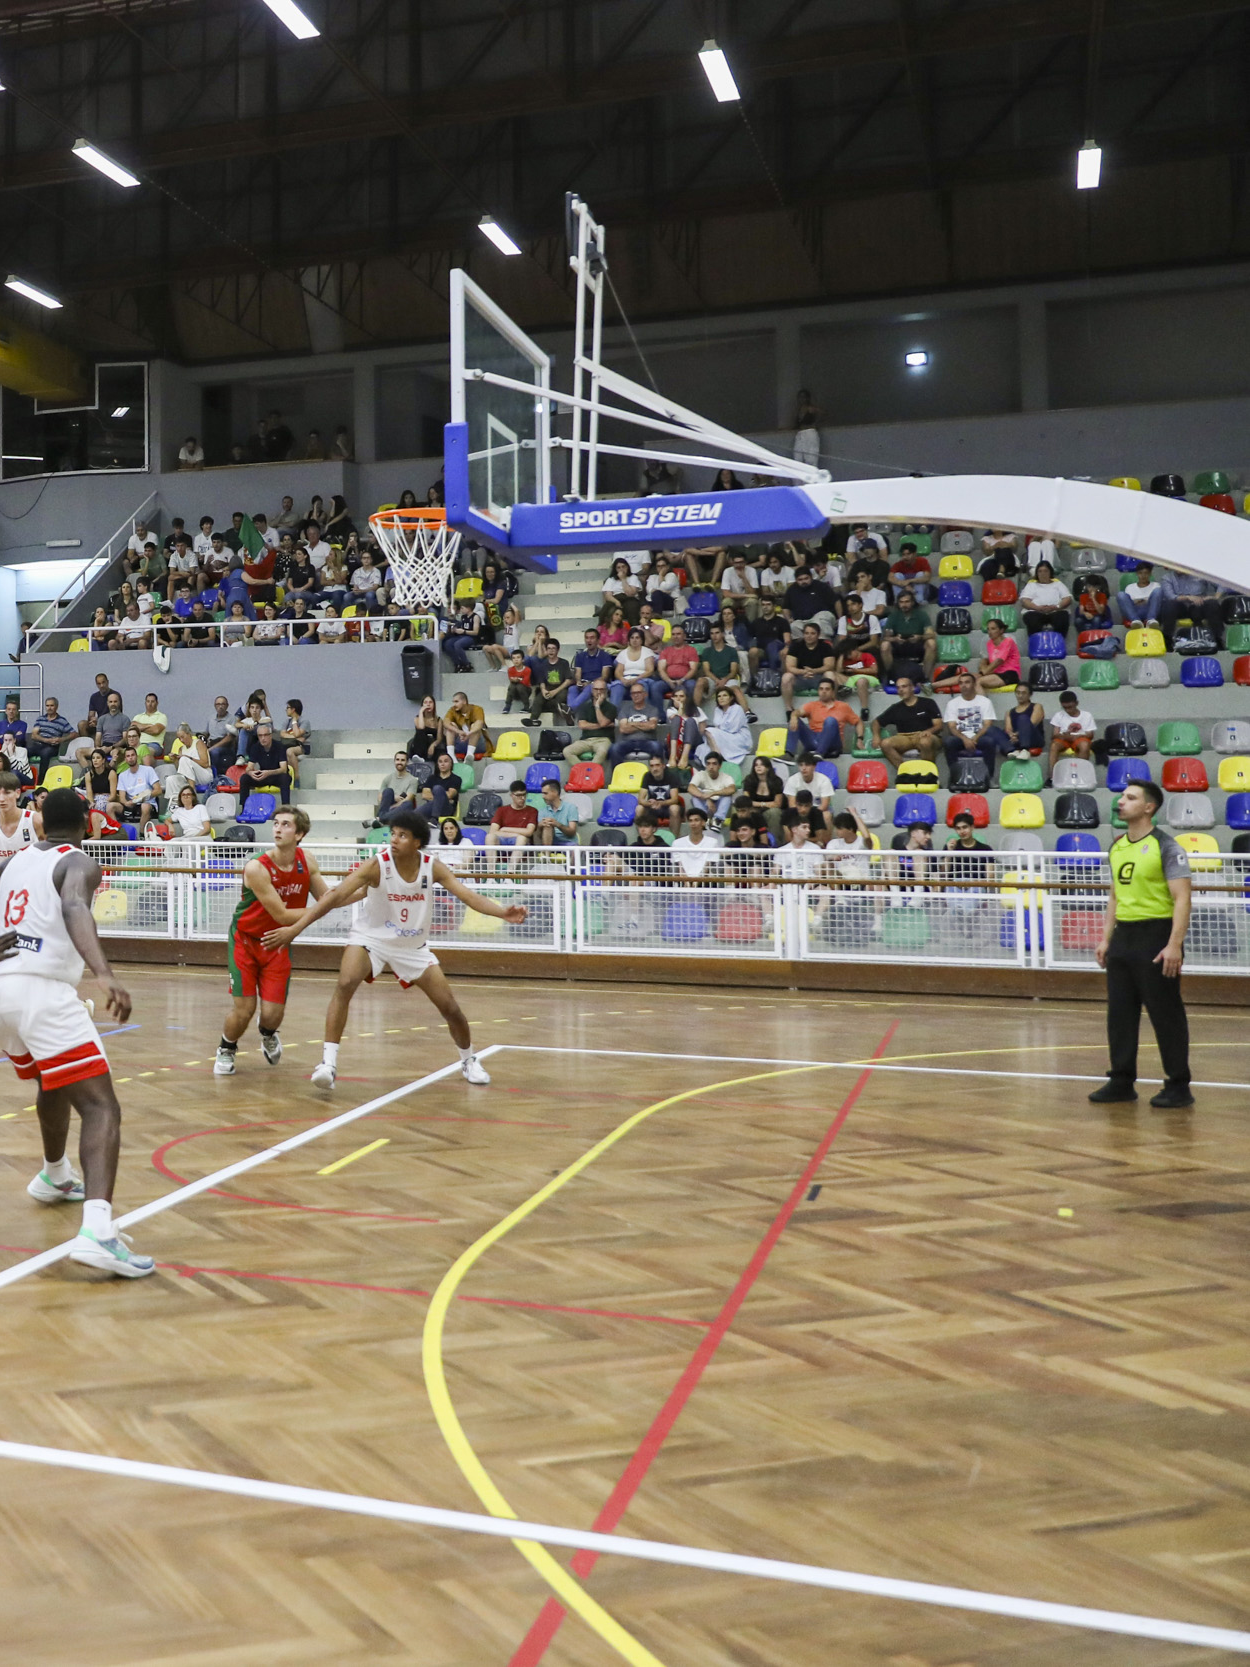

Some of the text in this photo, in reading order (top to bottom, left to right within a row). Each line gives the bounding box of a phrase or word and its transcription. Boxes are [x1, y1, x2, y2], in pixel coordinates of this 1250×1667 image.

[560, 502, 723, 528] SPORT SYSTEM
[387, 893, 426, 902] ESPAÑA
[4, 888, 30, 929] 13
[400, 908, 409, 923] 9
